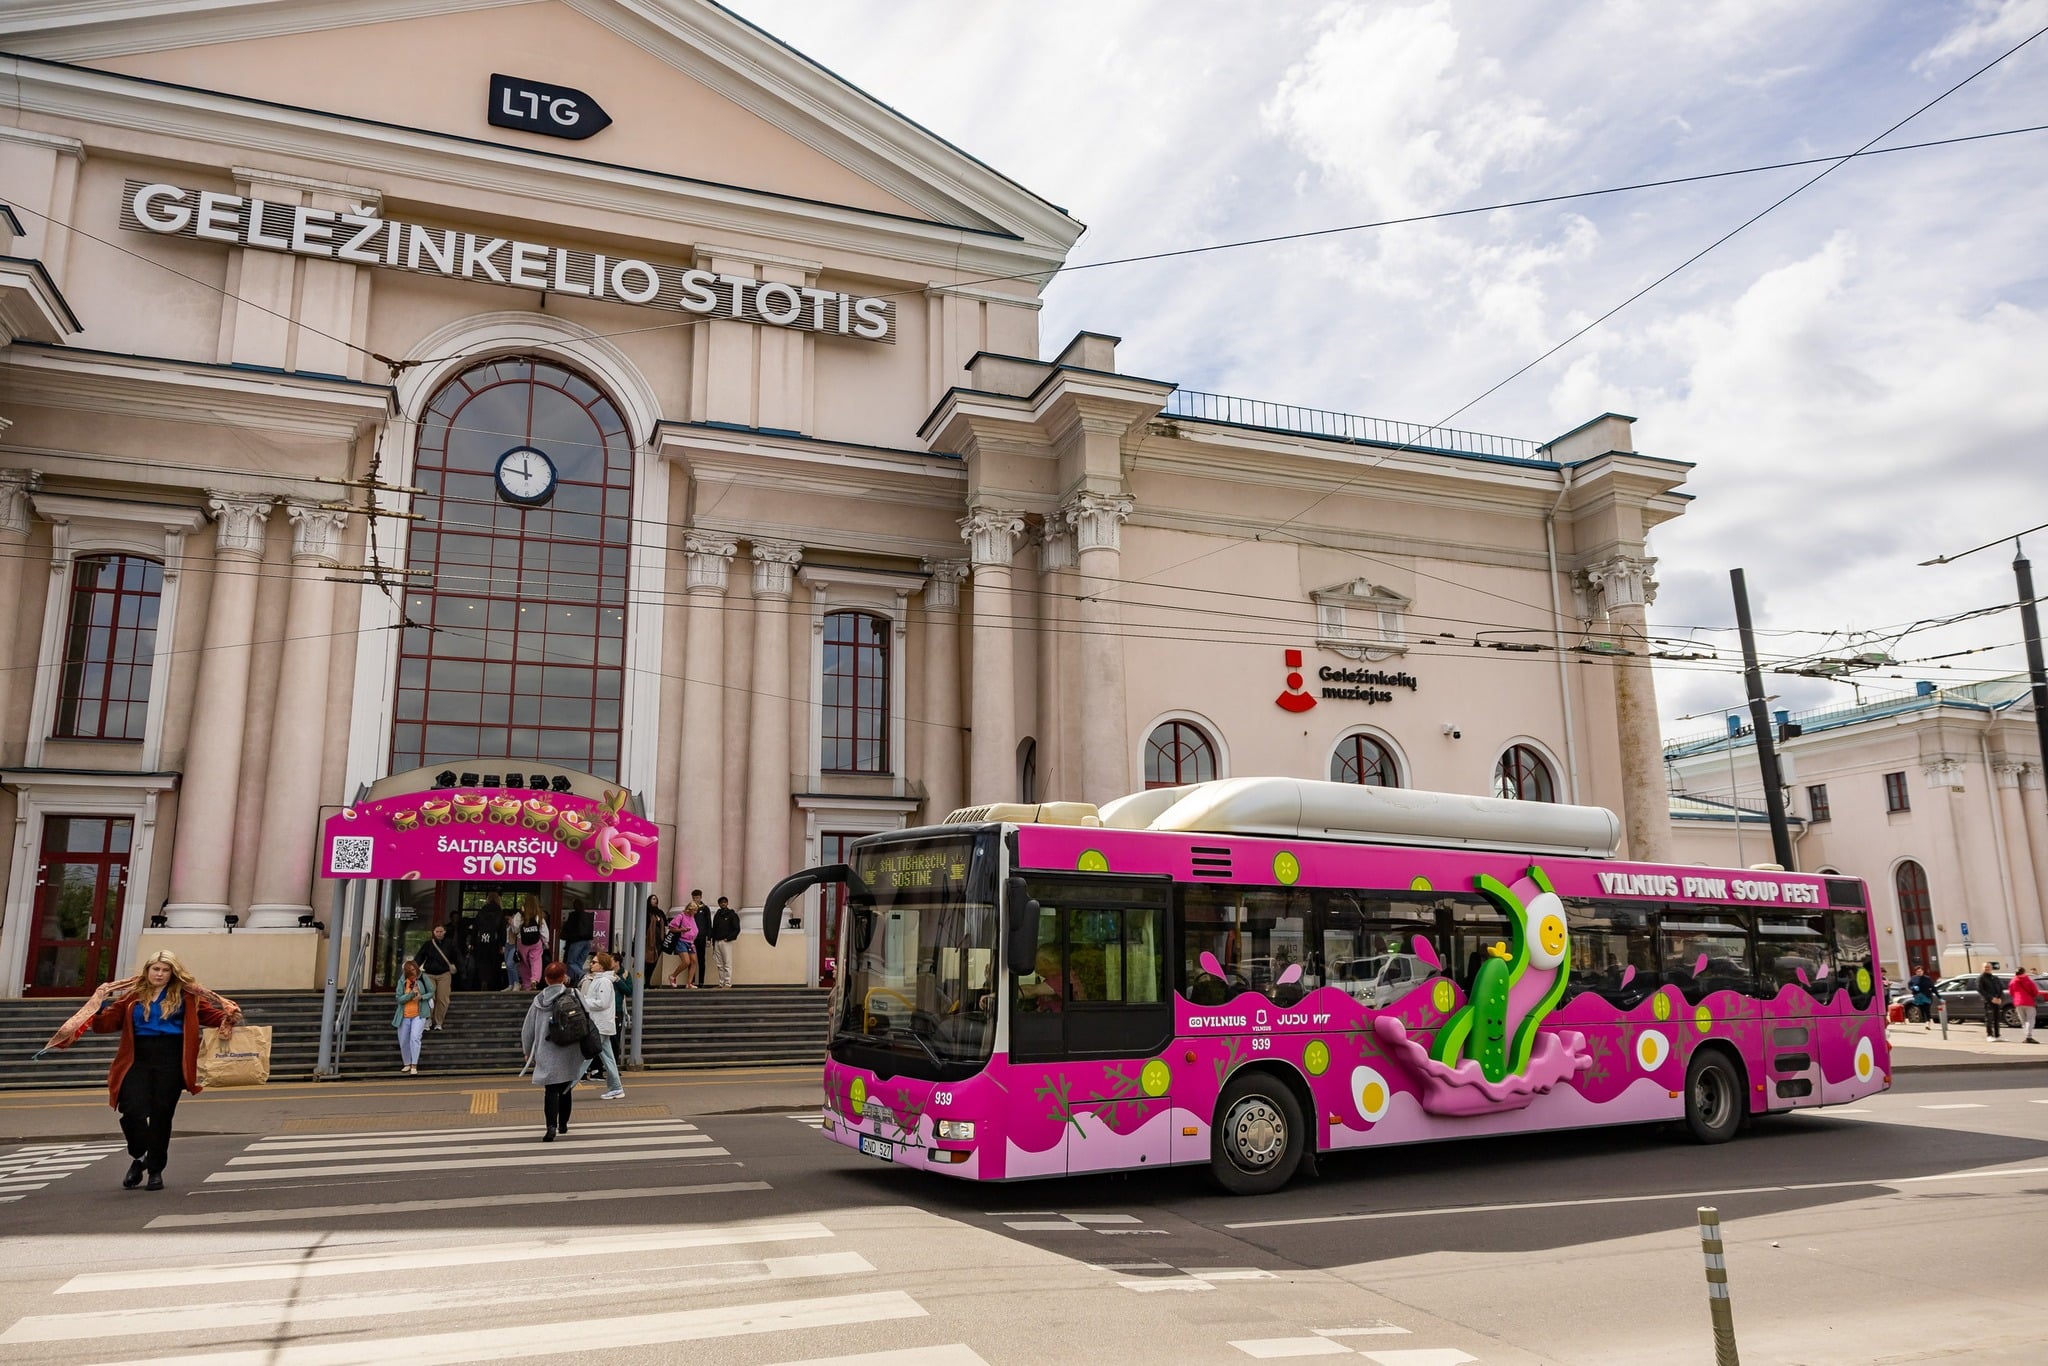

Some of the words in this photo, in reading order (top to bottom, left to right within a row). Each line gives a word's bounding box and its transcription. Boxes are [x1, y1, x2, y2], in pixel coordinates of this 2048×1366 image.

[502, 87, 580, 126] LTG
[133, 183, 660, 304] GELEŽINKELIO
[679, 269, 889, 340] STOTIS
[1319, 665, 1417, 691] Geležinkelių
[1321, 685, 1393, 705] muziejus
[437, 835, 558, 858] ŠALTIBARŠČIŲ
[462, 852, 537, 875] STOTIS
[1597, 872, 1679, 897] VILNIUS
[1681, 876, 1729, 899] PINK
[1731, 879, 1779, 902] SOUP
[1780, 882, 1820, 904] FEST
[1252, 1038, 1271, 1050] 939
[934, 1091, 953, 1106] 939
[879, 1142, 891, 1158] 527
